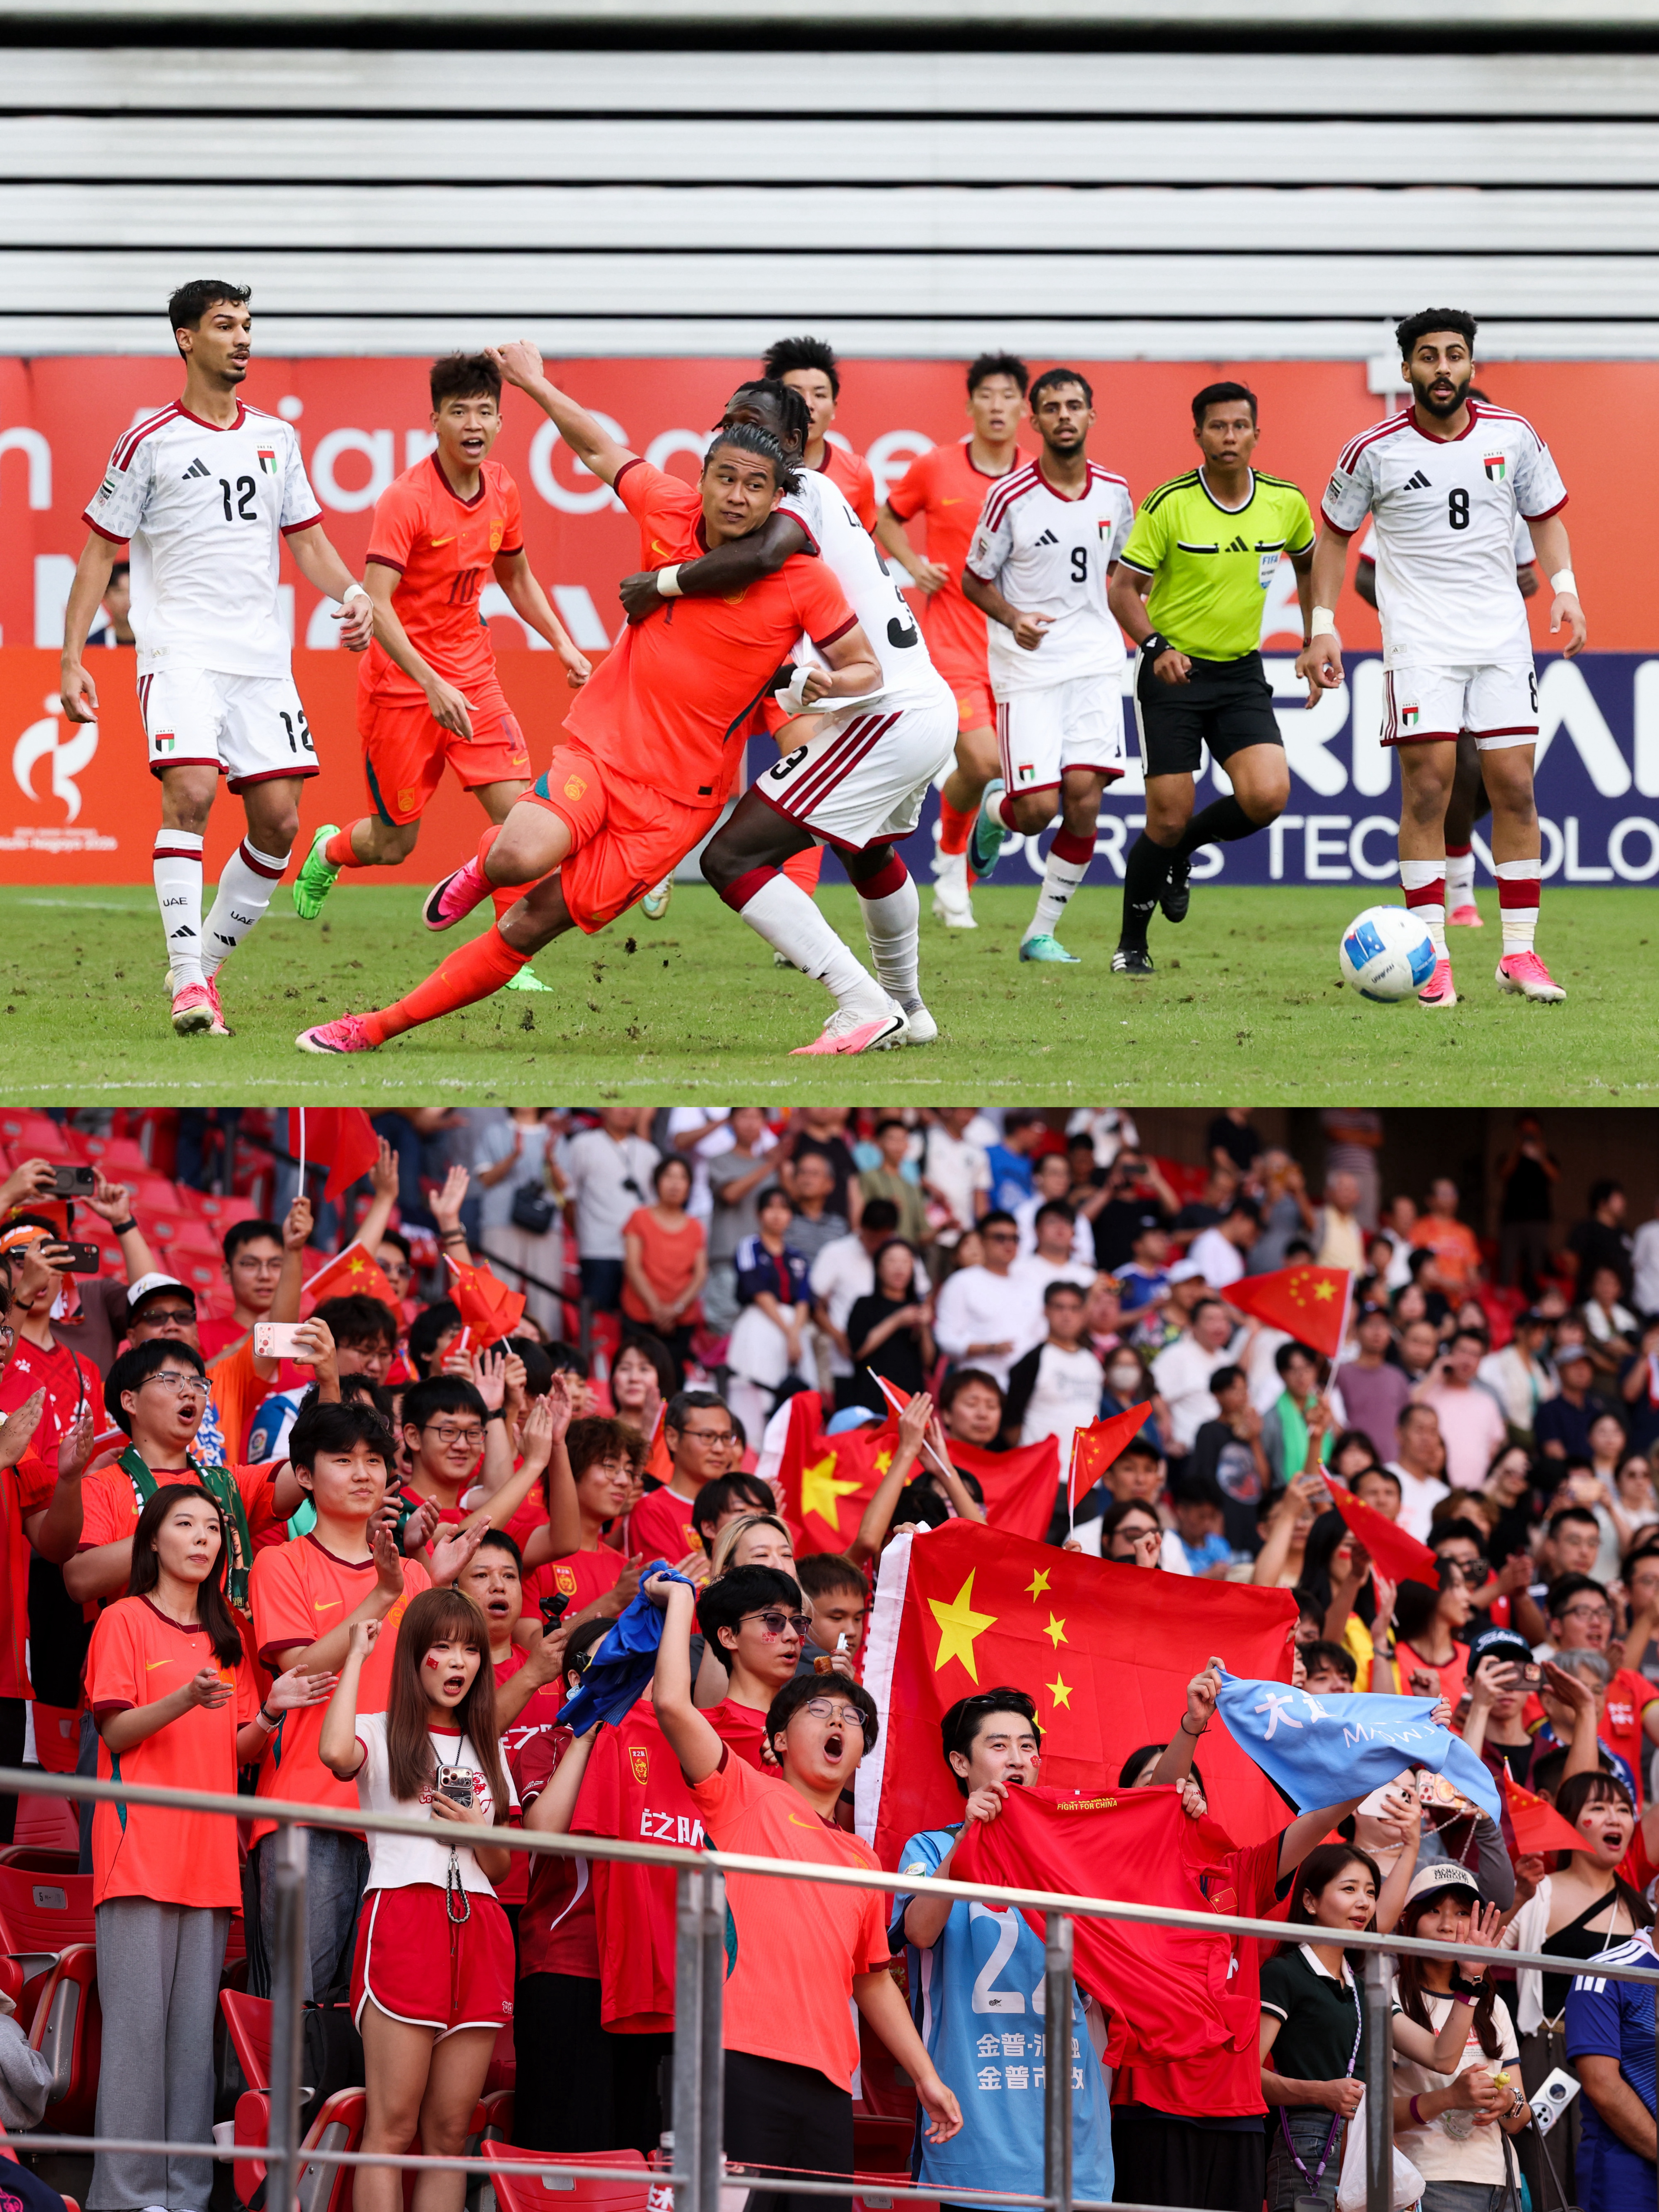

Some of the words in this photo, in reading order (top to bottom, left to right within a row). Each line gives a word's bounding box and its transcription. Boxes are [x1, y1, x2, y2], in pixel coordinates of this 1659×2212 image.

[219, 476, 257, 522] 12
[1448, 488, 1470, 530] 8
[1071, 546, 1087, 583] 9
[1263, 554, 1278, 565] FIFA
[447, 567, 481, 605] 10
[279, 709, 314, 753] 12
[770, 745, 808, 780] 3
[163, 897, 188, 907] UAE
[230, 911, 255, 925] UAE
[1096, 1800, 1118, 1809] CHINA
